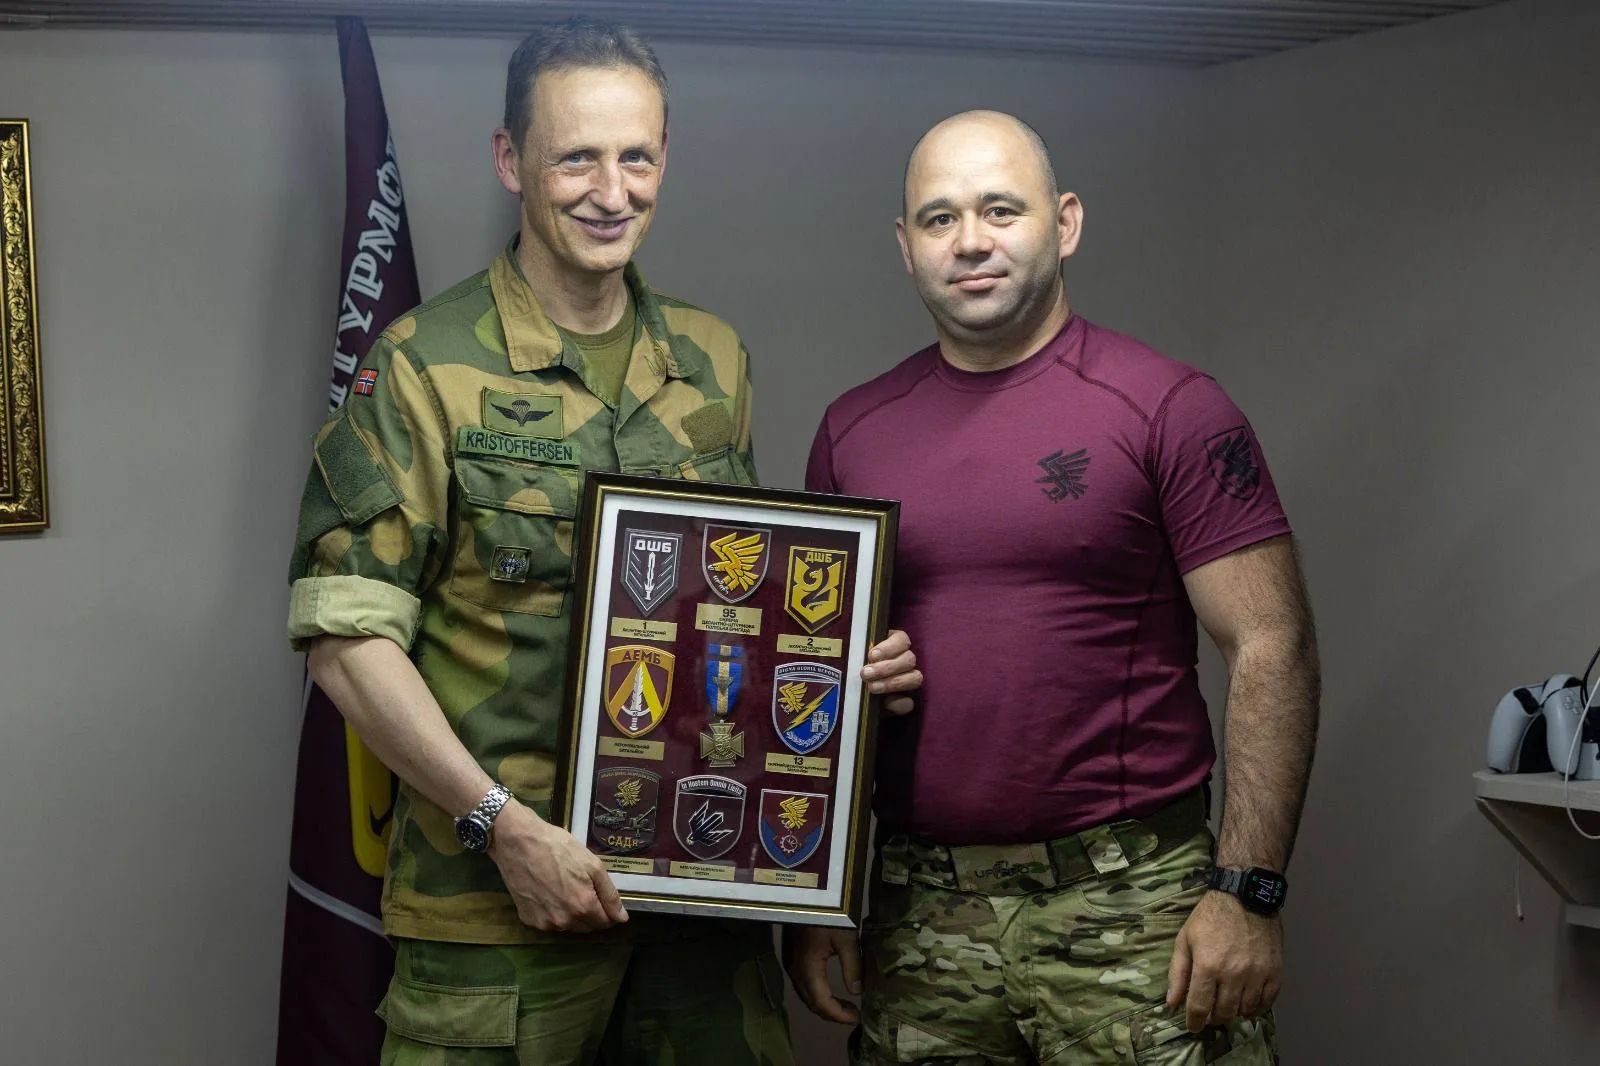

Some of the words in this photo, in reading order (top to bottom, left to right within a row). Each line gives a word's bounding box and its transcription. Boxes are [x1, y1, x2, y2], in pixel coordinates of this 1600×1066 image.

[466, 431, 573, 460] KRISTOFFERSEN
[634, 539, 672, 553] ДШБ
[805, 551, 833, 563] ДШБ
[722, 608, 737, 618] 95
[642, 621, 647, 629] 1
[807, 638, 814, 646] 2
[622, 649, 661, 665] АЕМБ
[794, 757, 804, 765] 13
